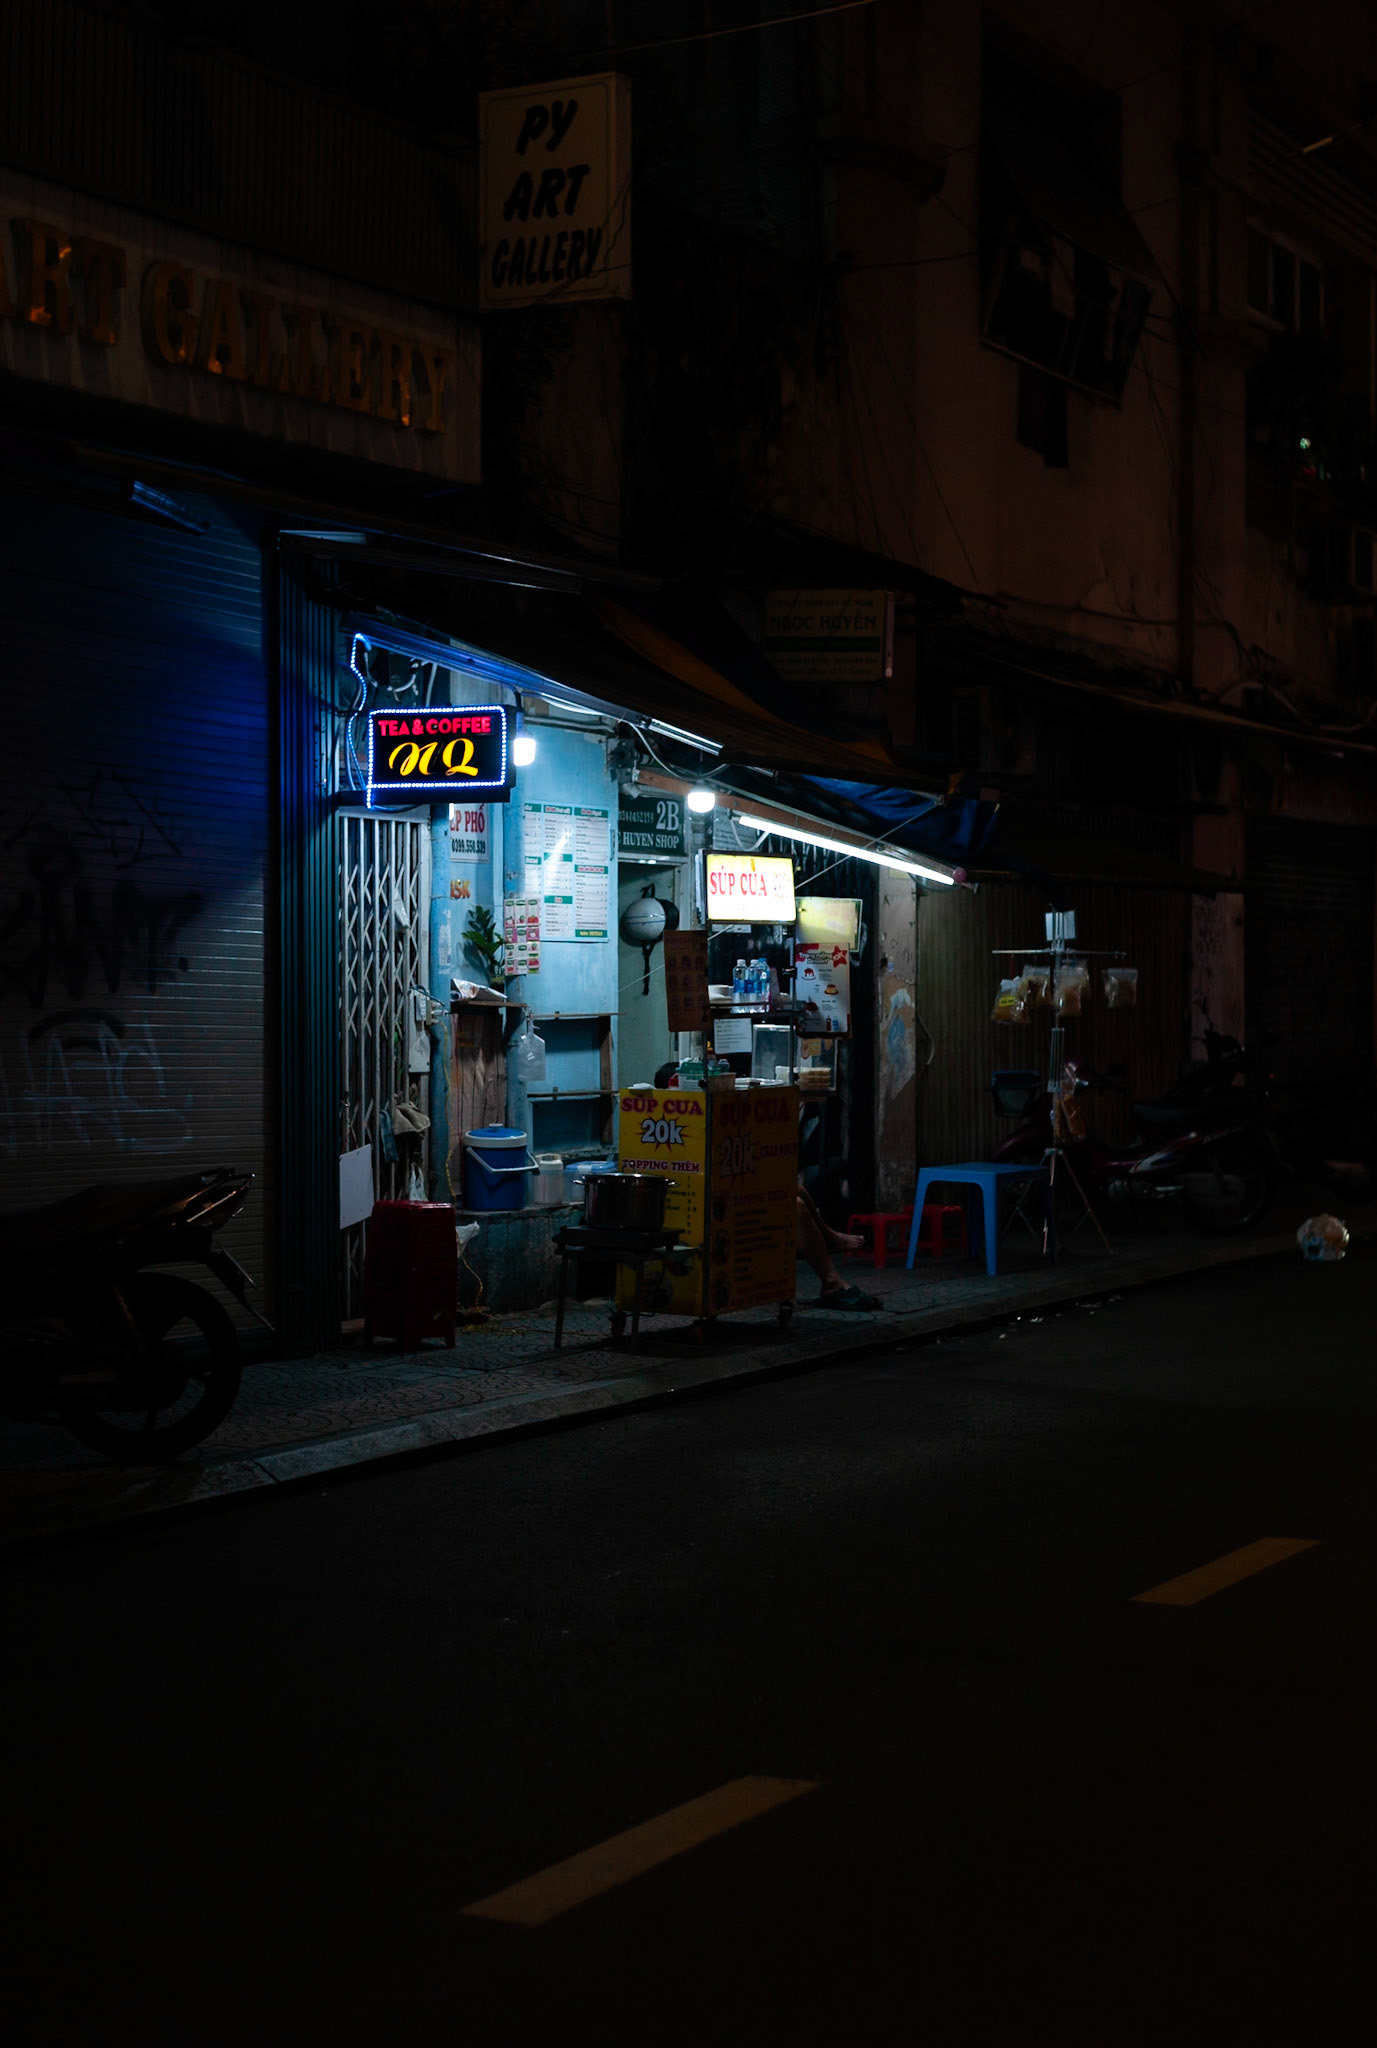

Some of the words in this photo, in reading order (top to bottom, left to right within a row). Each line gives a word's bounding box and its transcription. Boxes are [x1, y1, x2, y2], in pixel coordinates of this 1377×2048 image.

[515, 99, 578, 156] PY
[502, 163, 590, 222] ART
[491, 227, 603, 289] GALLERY
[141, 259, 456, 433] GALLERY
[656, 800, 680, 831] 2B
[622, 831, 654, 847] HUYEN
[655, 834, 680, 849] SHOP
[709, 864, 736, 896] SÚP
[663, 1098, 704, 1116] CUA
[754, 1098, 790, 1123] CUA
[622, 1158, 669, 1171] TOPPING
[671, 1160, 701, 1173] THÊM
